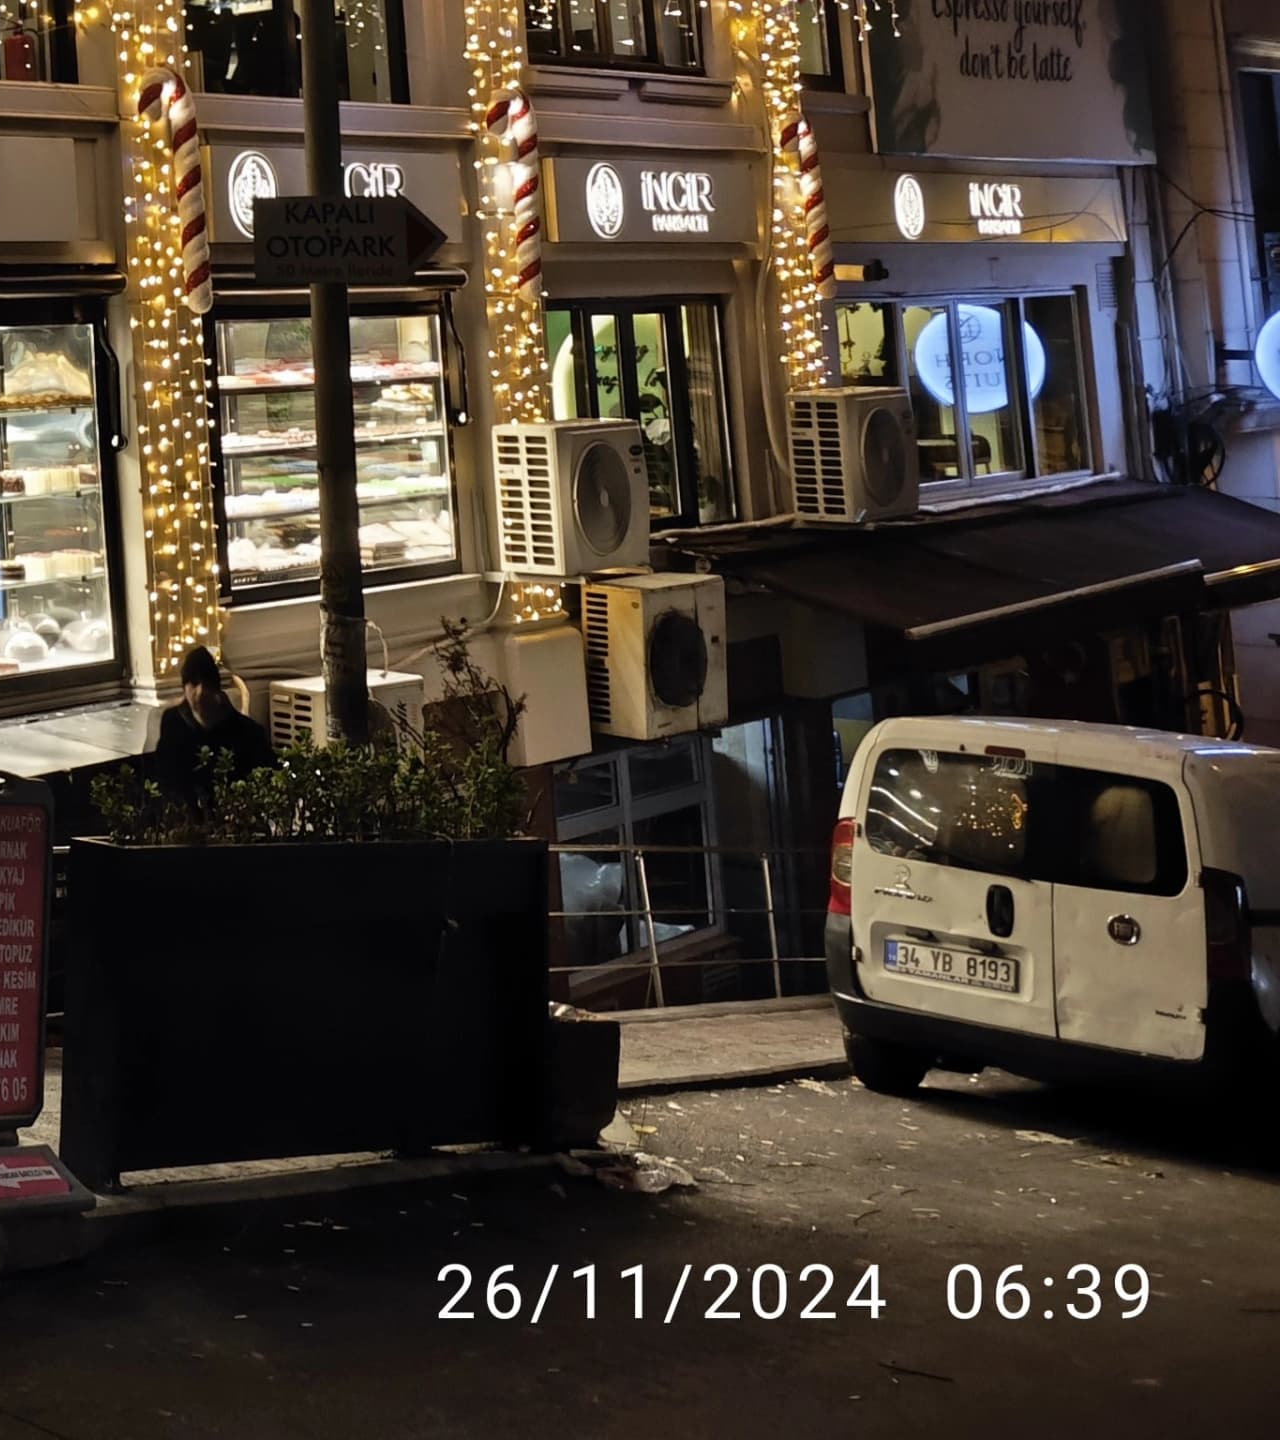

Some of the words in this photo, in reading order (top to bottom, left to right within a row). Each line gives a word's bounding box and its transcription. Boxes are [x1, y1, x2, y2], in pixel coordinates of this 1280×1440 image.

[960, 37, 1003, 80] don't
[1008, 42, 1029, 81] be
[1033, 44, 1072, 82] latte
[285, 201, 375, 224] KAPALI
[266, 235, 395, 258] OTOPARK
[0, 944, 33, 964] TOPUZ
[898, 946, 920, 968] 34
[930, 949, 953, 973] YB
[966, 956, 1011, 983] 8193
[12, 1077, 28, 1101] 05
